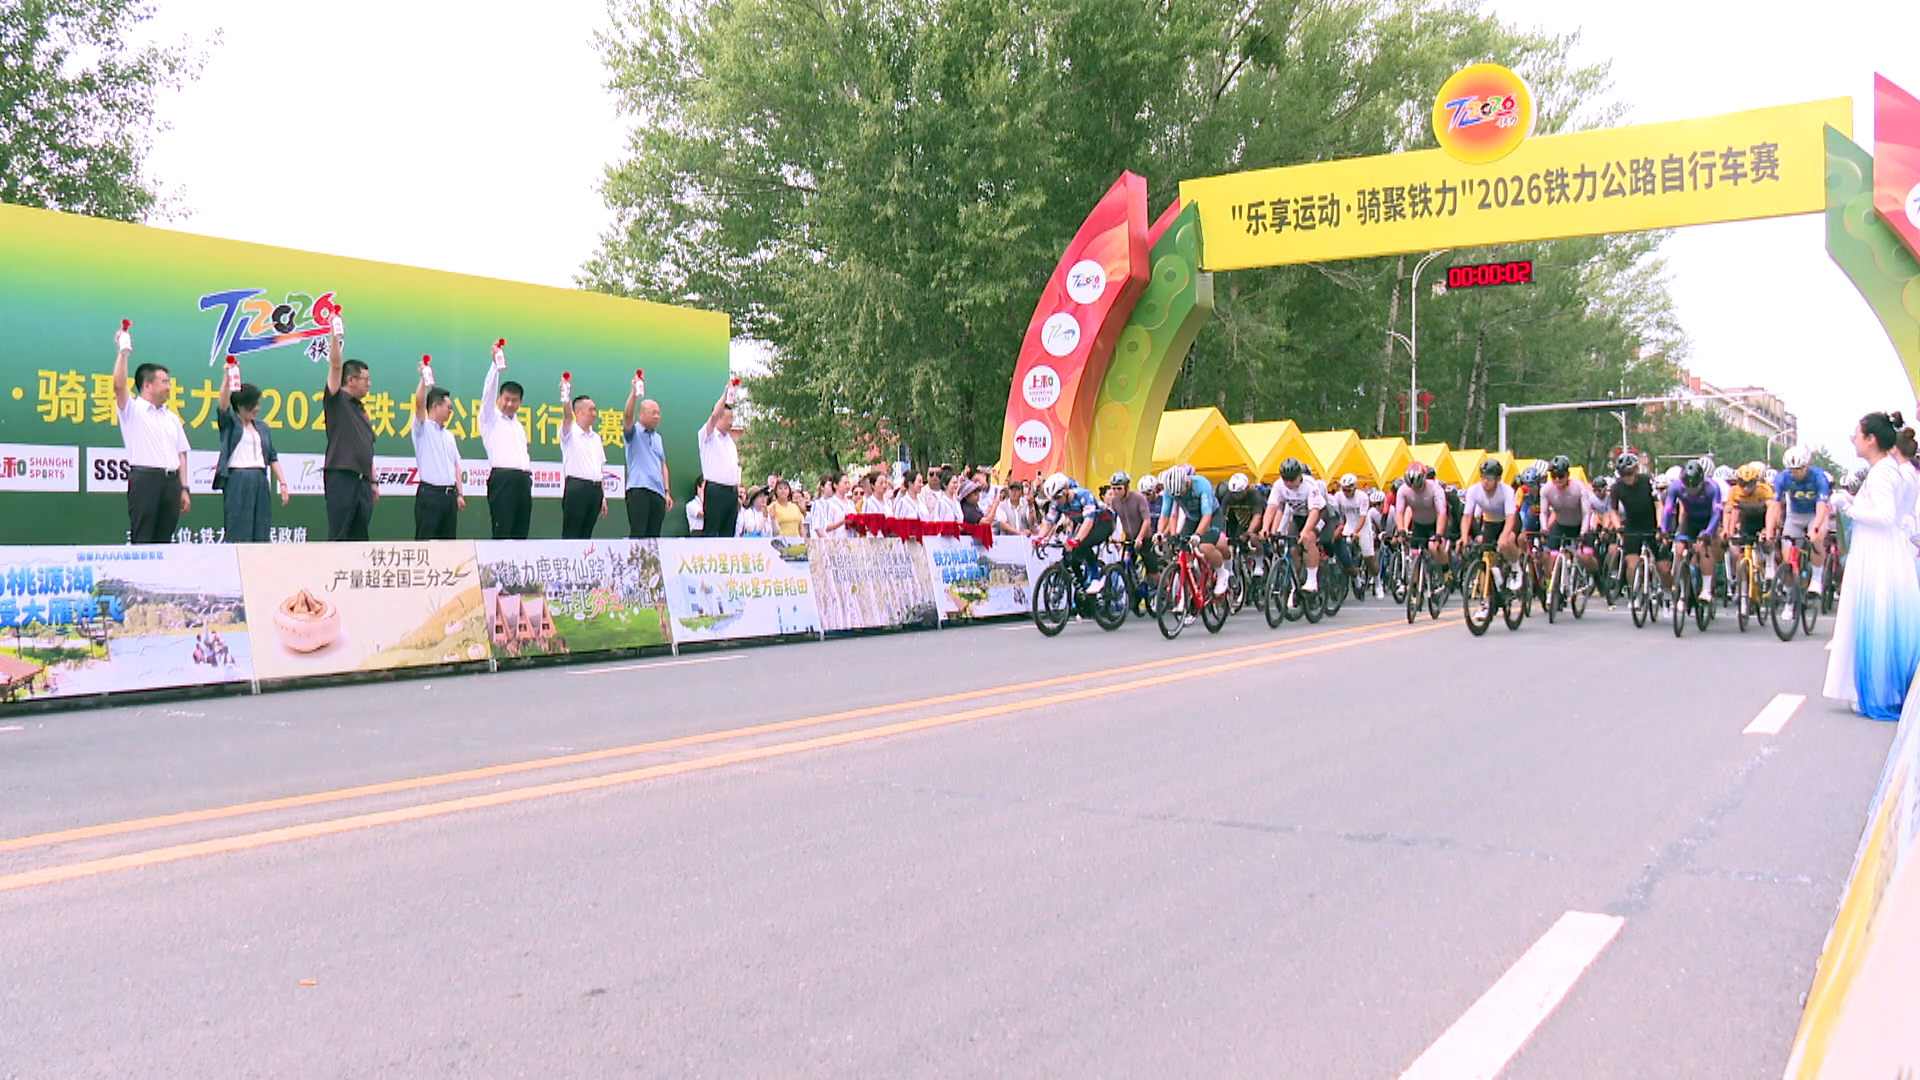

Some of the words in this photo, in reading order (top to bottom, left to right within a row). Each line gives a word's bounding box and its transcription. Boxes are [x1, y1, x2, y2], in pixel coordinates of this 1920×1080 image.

[1448, 261, 1532, 288] 00:00:02
[29, 456, 74, 468] SHANGHE
[29, 469, 66, 480] SPORTS
[363, 547, 430, 567] 铁力平贝
[678, 551, 765, 576] 入铁力星月童话
[0, 565, 95, 597] 桃源湖
[325, 568, 471, 592] 产量超全国三分之一
[725, 576, 808, 602] 赏北星万亩稻田
